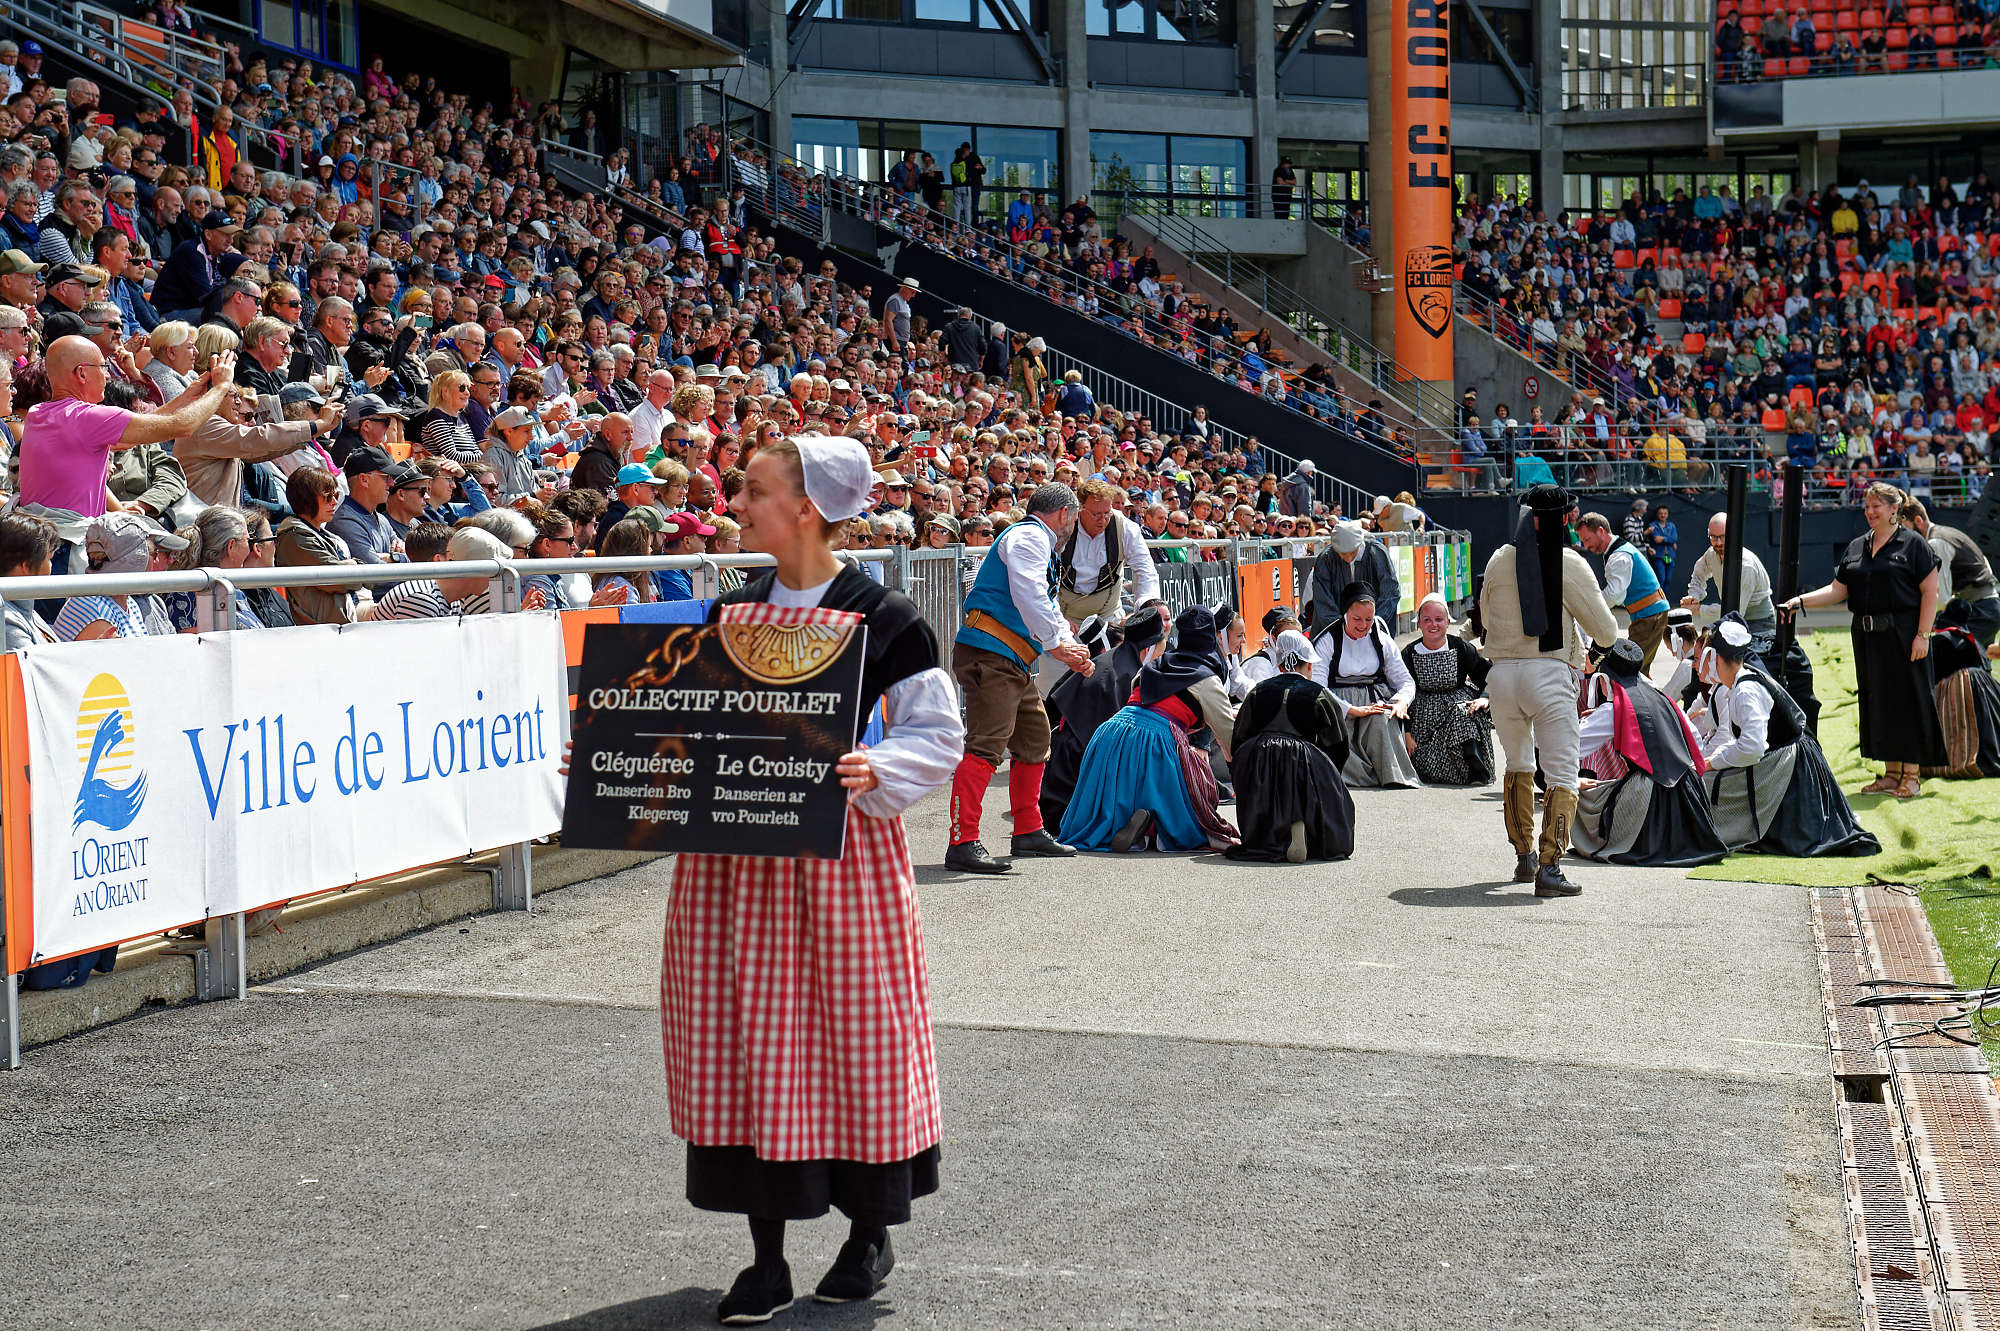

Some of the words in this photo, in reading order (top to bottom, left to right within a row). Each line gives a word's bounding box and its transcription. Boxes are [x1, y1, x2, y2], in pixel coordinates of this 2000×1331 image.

[1407, 124, 1450, 189] FC
[1407, 273, 1421, 286] FC
[1424, 273, 1452, 286] LORIE
[588, 688, 720, 711] COLLECTIF
[723, 691, 841, 715] POURLET
[183, 714, 317, 820] Ville
[335, 705, 385, 796] de
[398, 690, 546, 784] Lorient
[591, 751, 695, 778] Cléguérec
[716, 754, 743, 776] Le
[748, 755, 831, 783] Croisty
[596, 783, 664, 798] Danserien
[666, 785, 692, 799] Bro
[713, 786, 786, 803] Danserien
[788, 791, 806, 803] ar
[627, 805, 689, 824] Klegereg
[711, 811, 735, 823] vro
[737, 809, 800, 826] Pourleth
[72, 836, 149, 880] LORIENT
